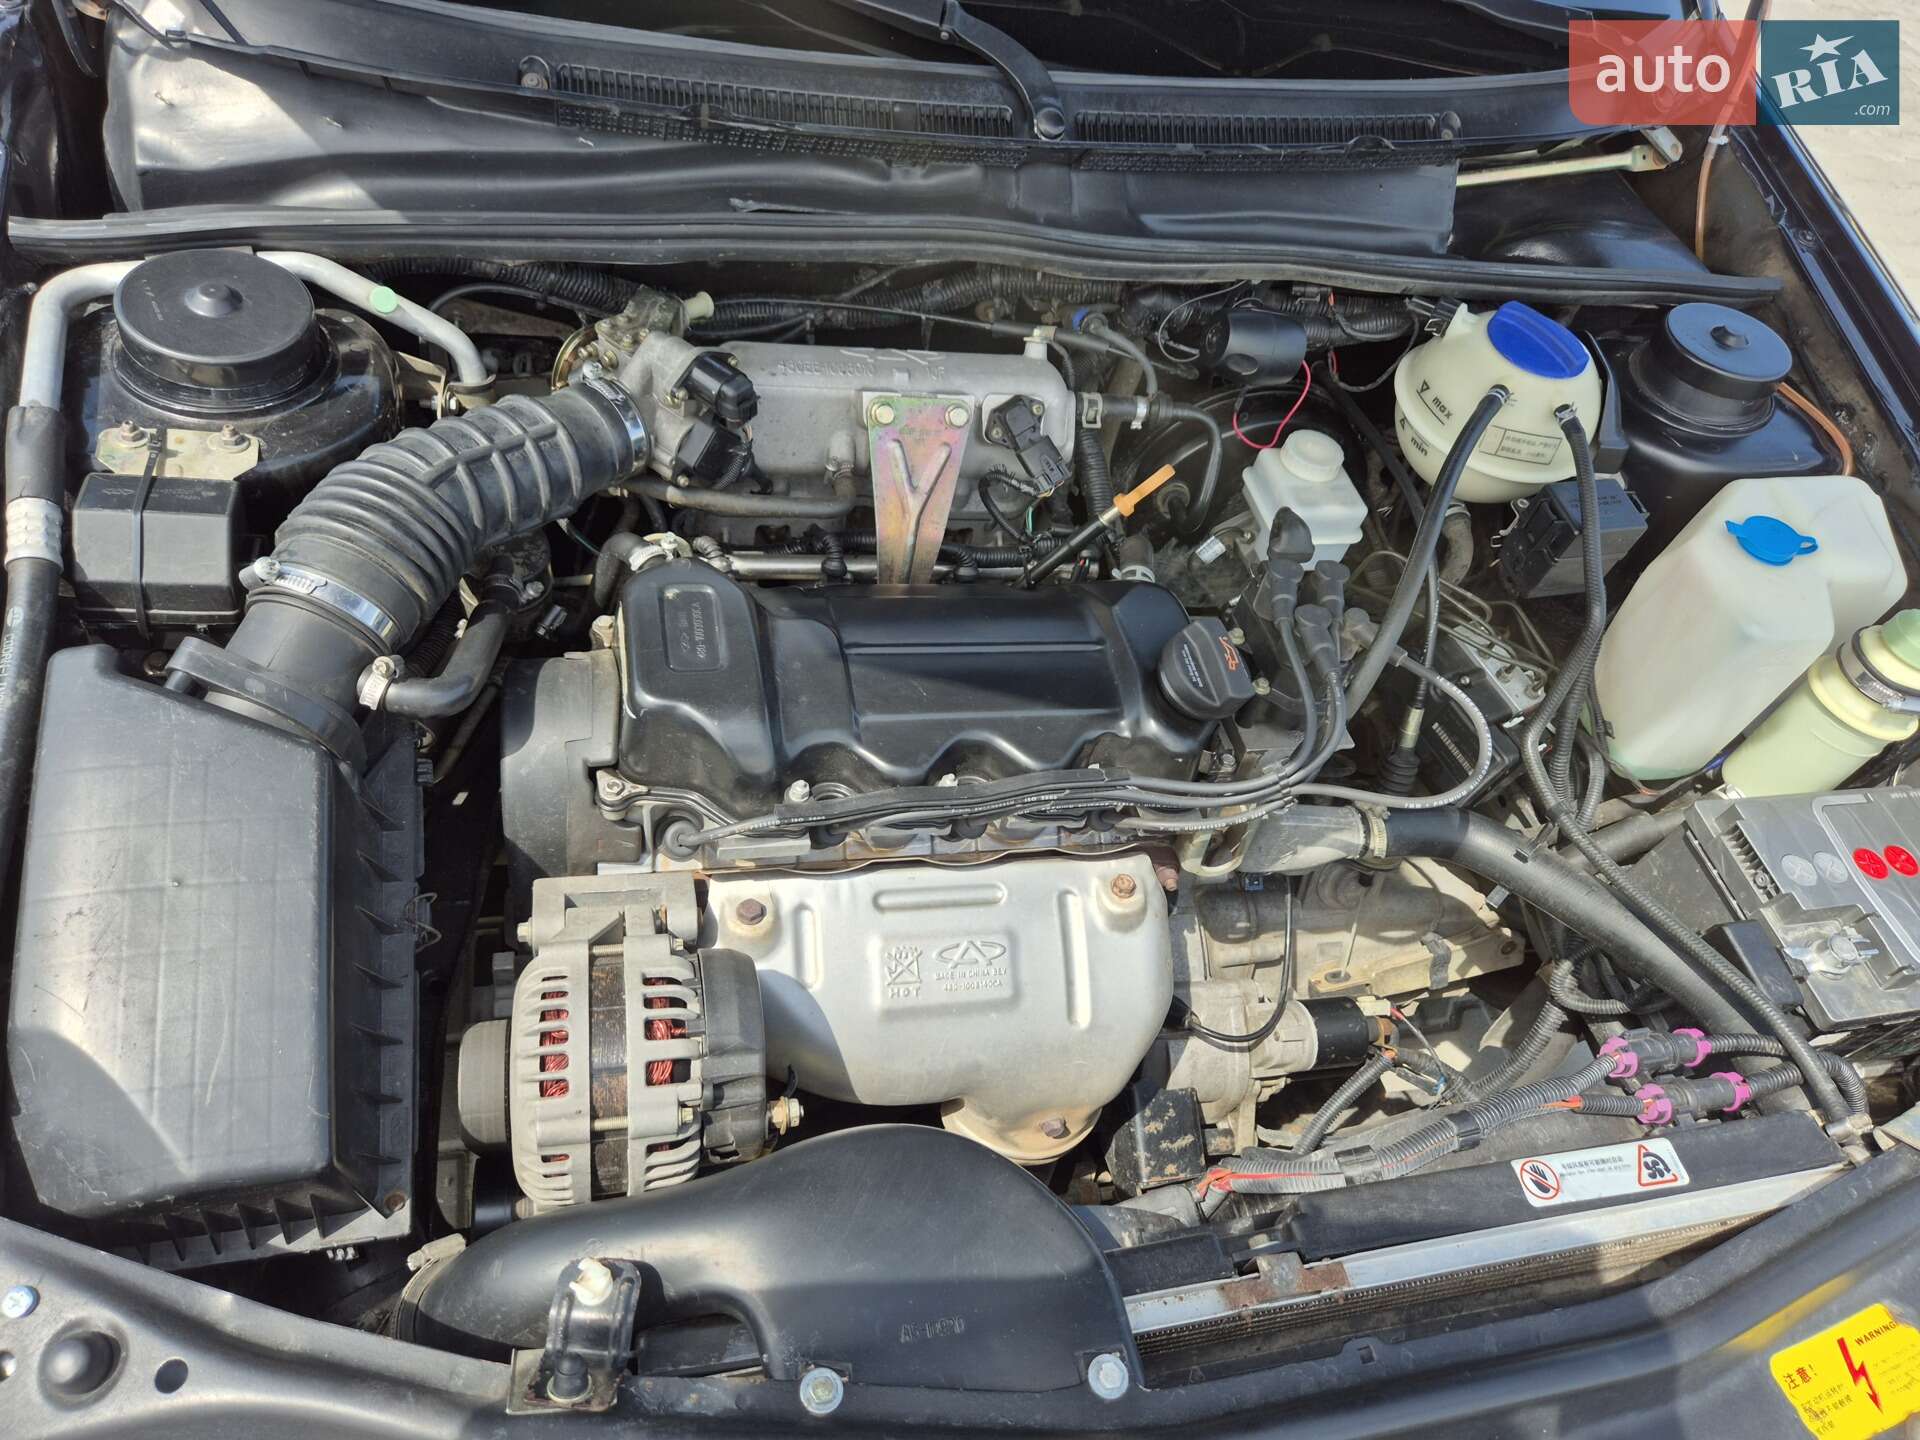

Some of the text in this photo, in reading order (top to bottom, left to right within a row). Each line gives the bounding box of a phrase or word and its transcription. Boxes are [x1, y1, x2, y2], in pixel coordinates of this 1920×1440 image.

[1432, 396, 1453, 420] max
[1411, 437, 1428, 457] min
[889, 987, 921, 999] HOT
